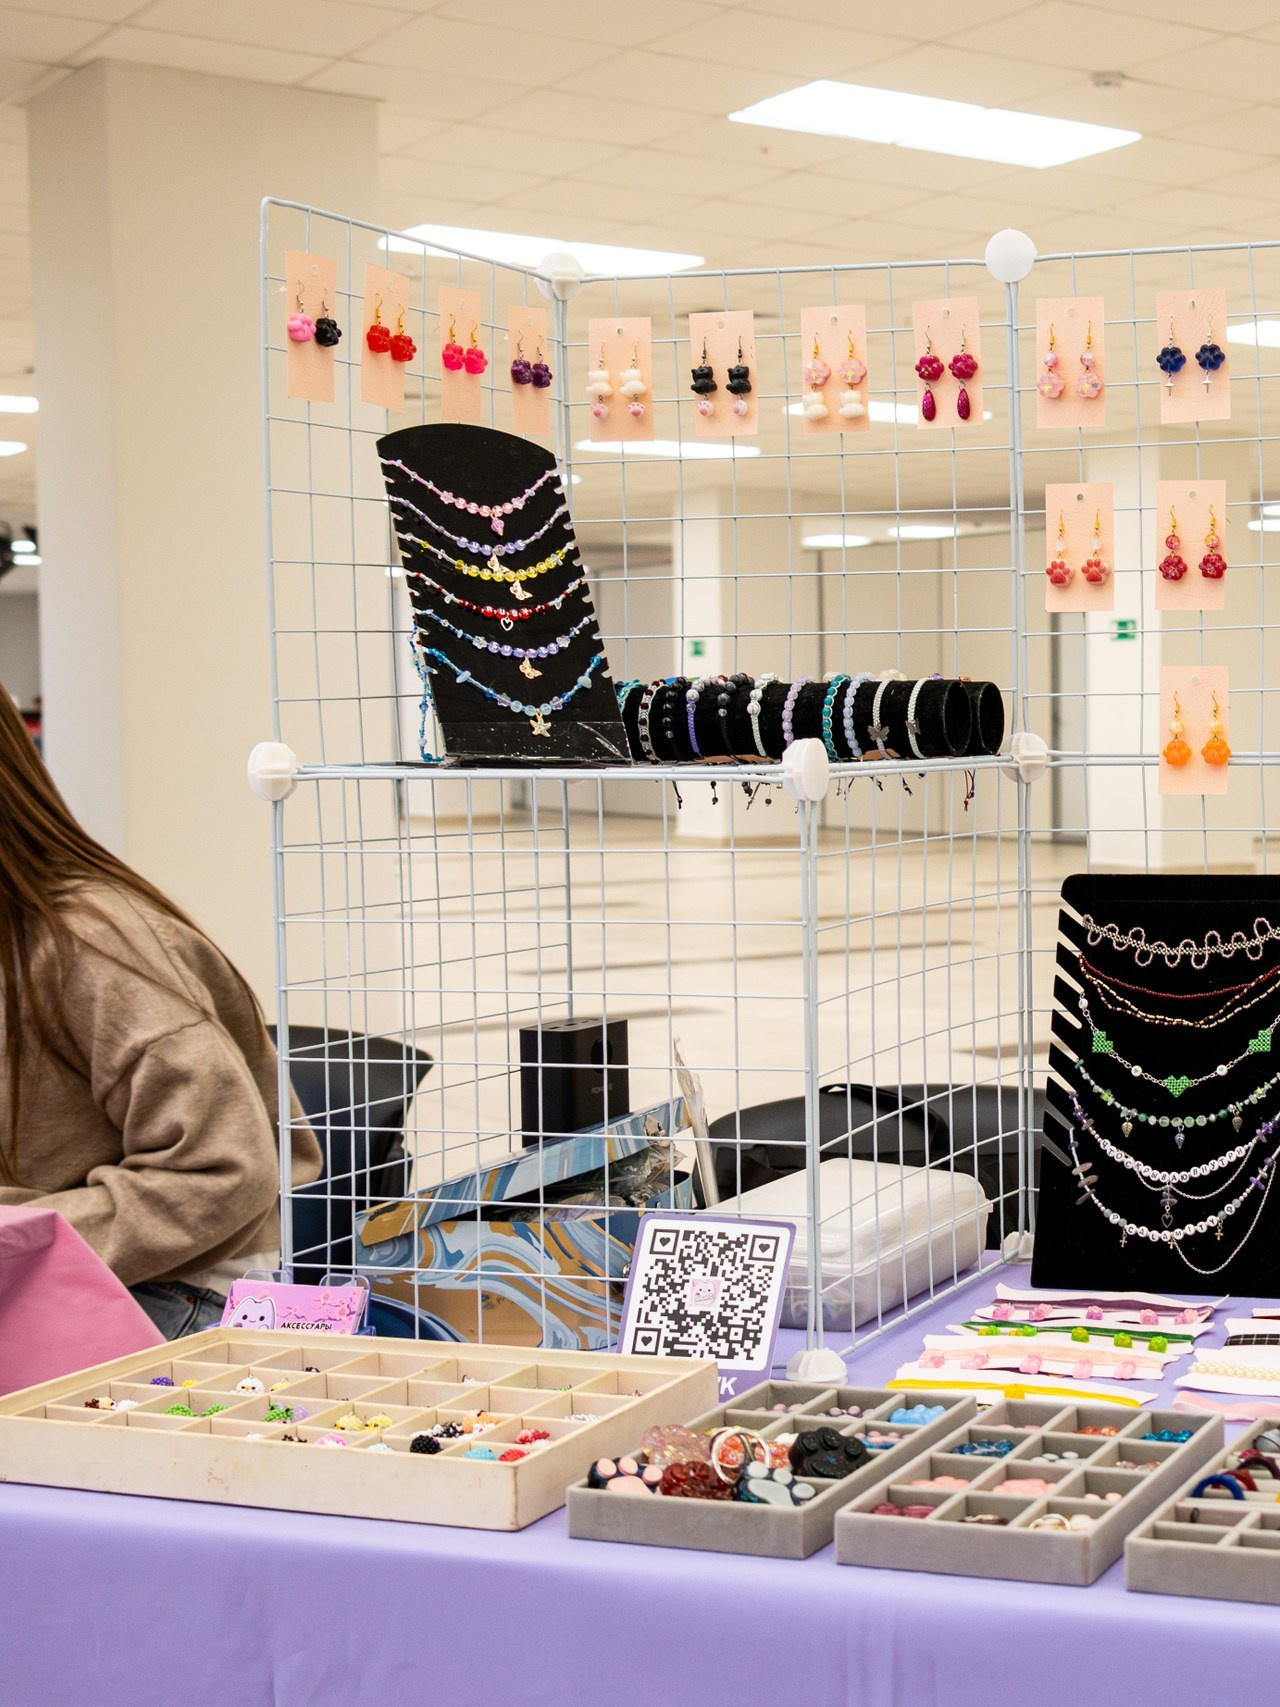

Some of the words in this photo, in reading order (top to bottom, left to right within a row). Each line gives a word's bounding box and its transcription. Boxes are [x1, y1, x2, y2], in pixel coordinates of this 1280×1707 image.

[1101, 1140, 1124, 1162] ЧТО
[1124, 1161, 1189, 1182] СКРЫВАЮ
[1127, 1218, 1217, 1241] CALAMITY
[280, 1322, 332, 1330] АКСЕССУАРЫ
